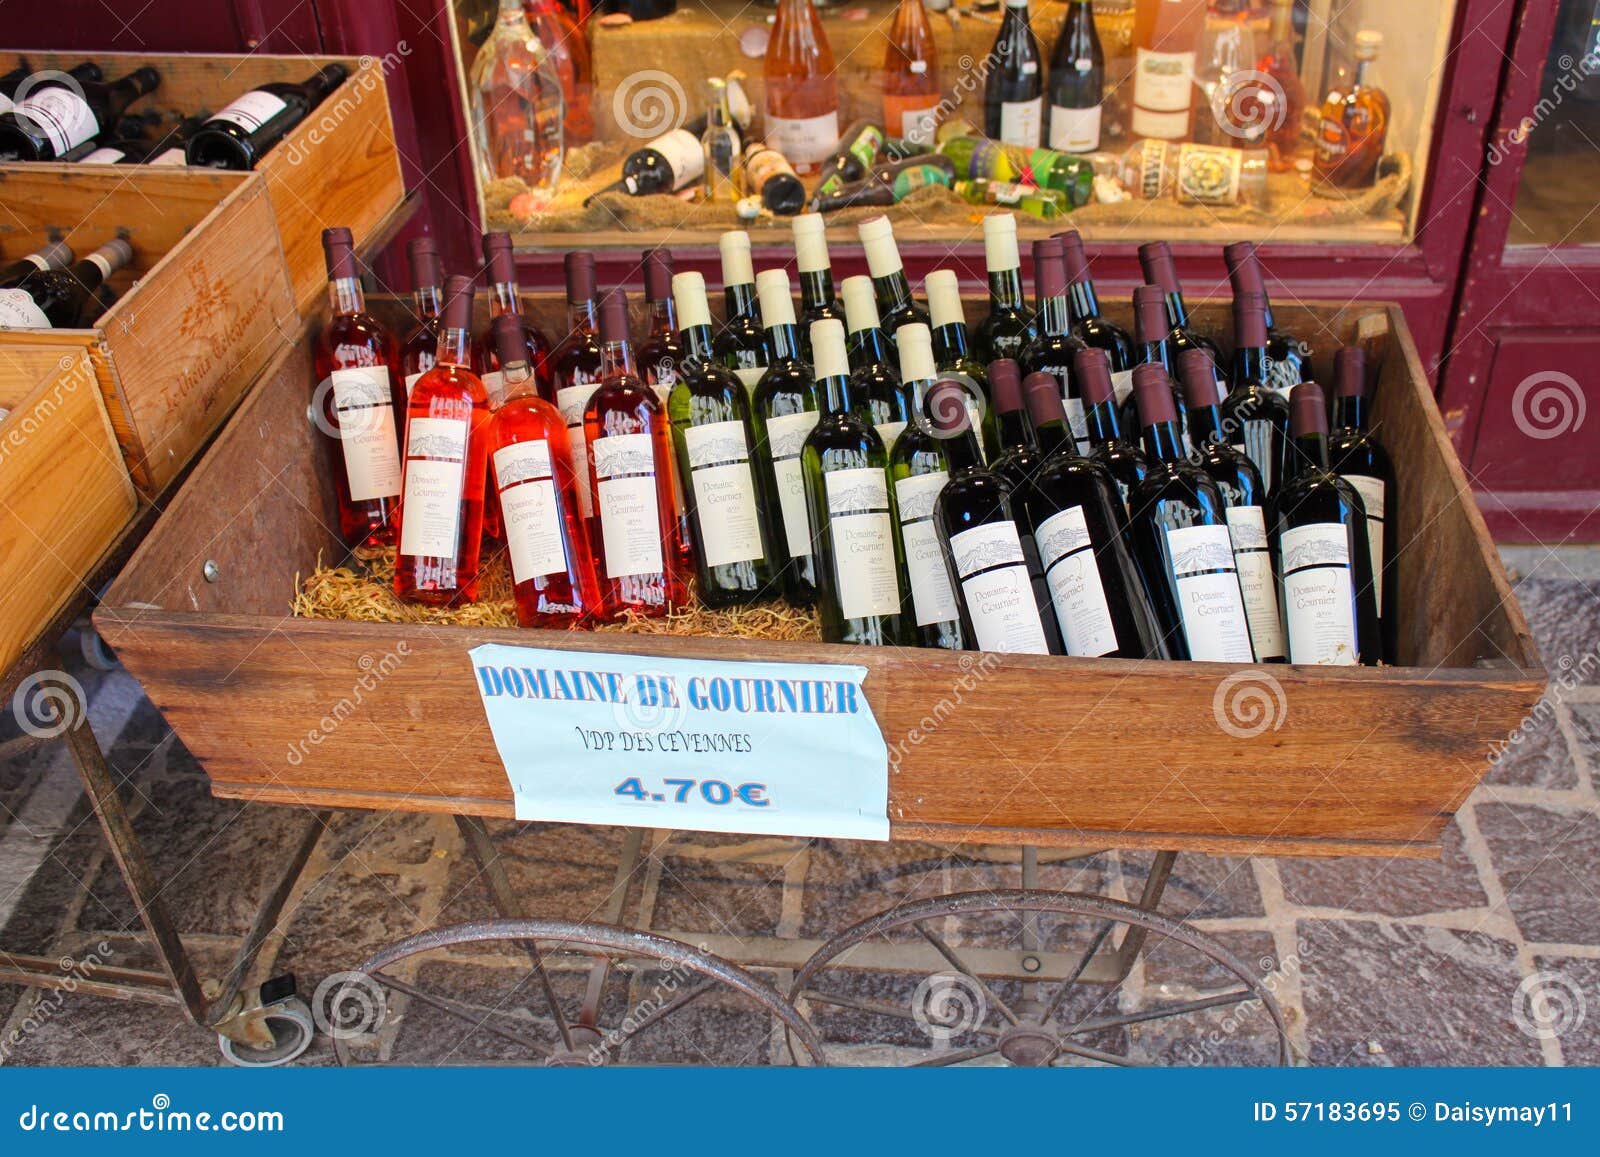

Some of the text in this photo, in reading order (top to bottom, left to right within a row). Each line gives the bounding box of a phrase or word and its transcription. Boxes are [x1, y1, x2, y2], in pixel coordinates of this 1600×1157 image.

[477, 665, 859, 715] DOMAINE DE GOURNIER
[575, 726, 753, 753] VDP DES CEVENNES
[613, 776, 770, 807] 4.70€
